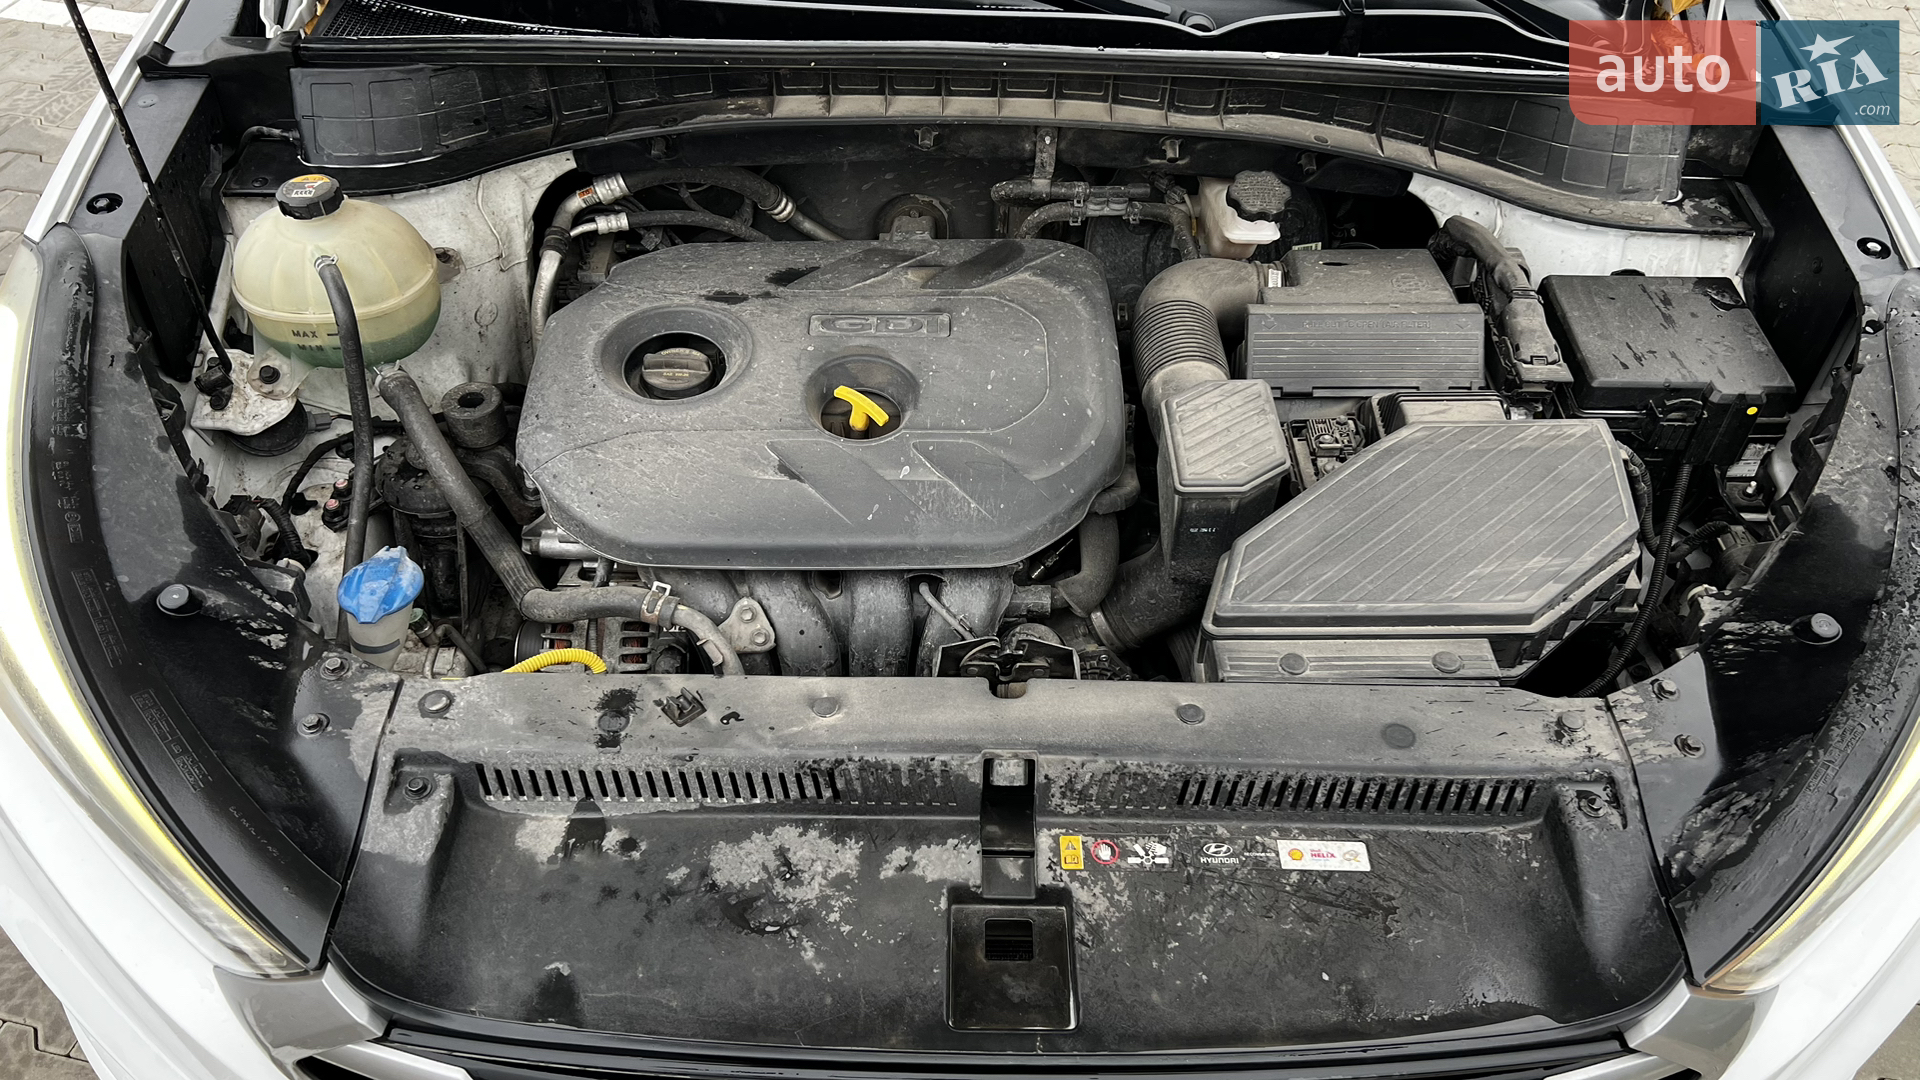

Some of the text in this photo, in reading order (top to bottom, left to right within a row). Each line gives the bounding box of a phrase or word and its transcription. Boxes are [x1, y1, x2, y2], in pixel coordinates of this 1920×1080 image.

[819, 315, 940, 334] GDI
[1356, 320, 1379, 329] OPEN
[291, 329, 319, 339] MAX
[297, 343, 325, 352] MIN
[1200, 856, 1240, 864] HYUNDAI
